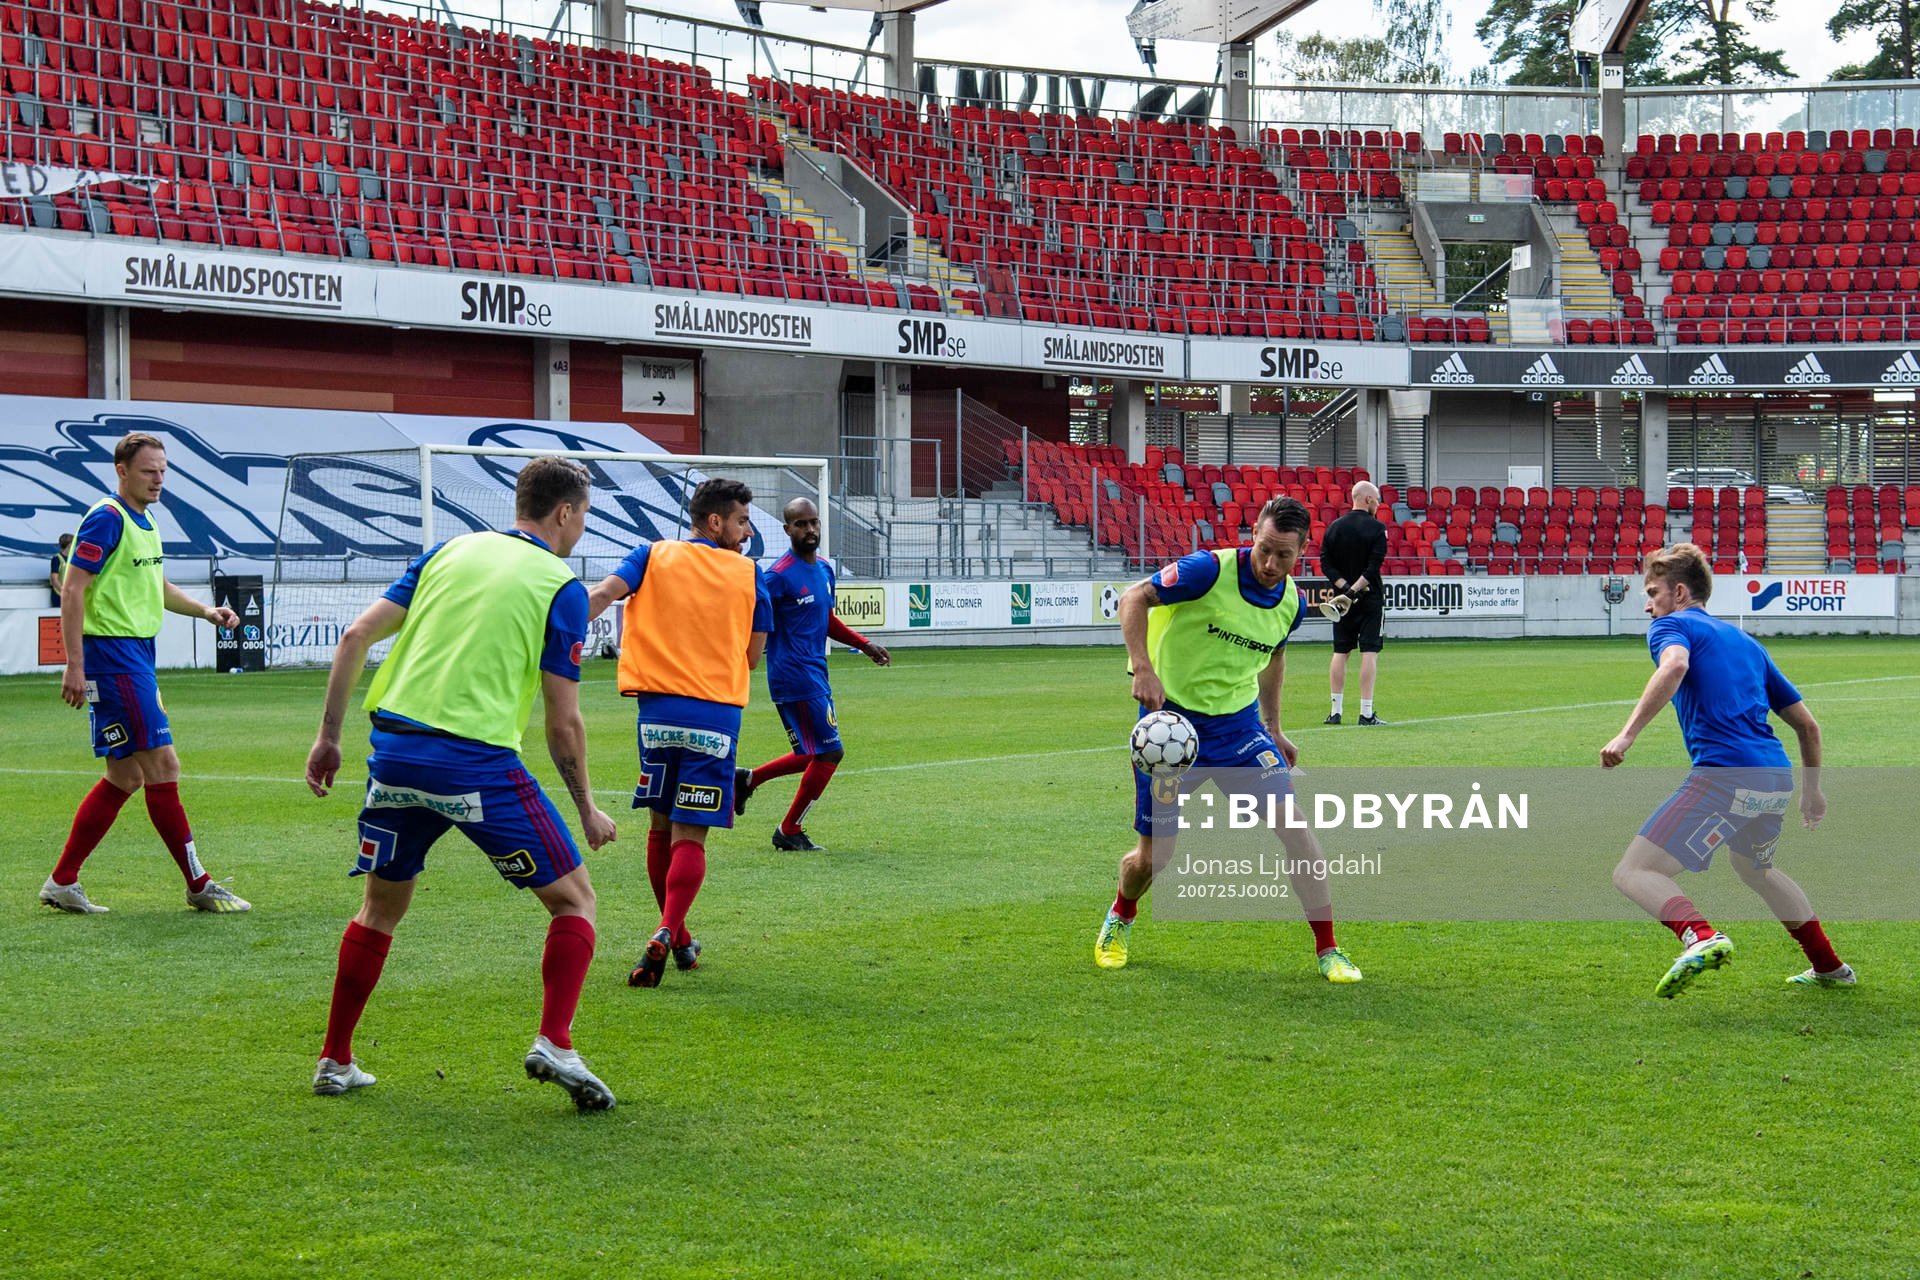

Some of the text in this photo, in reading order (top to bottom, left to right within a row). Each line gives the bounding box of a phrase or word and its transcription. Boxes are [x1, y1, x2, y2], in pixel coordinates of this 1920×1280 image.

[125, 253, 342, 302] SMÅLANDSPOSTEN
[461, 280, 551, 327] SMP.se
[655, 301, 811, 340] SMÅLANDSPOSTEN
[898, 319, 966, 358] SMP.se
[1044, 334, 1164, 366] SMÅLANDSPOSTEN
[1260, 346, 1343, 380] SMP.se
[1430, 371, 1475, 384] adidas
[1521, 372, 1565, 384] adidas
[1611, 372, 1654, 385] adidas
[1688, 371, 1735, 385] adidas
[1784, 371, 1831, 384] adidas
[1532, 391, 1543, 402] C2
[1468, 586, 1494, 598] Skyltar
[1787, 580, 1846, 595] INTER
[935, 598, 982, 608] ROYAL CORNER
[1035, 597, 1078, 607] ROYAL CORNER
[1468, 598, 1498, 608] lysande
[1786, 596, 1846, 612] SPORT
[217, 640, 238, 649] OBOS
[242, 641, 264, 650] OBOS
[679, 790, 714, 804] griffel
